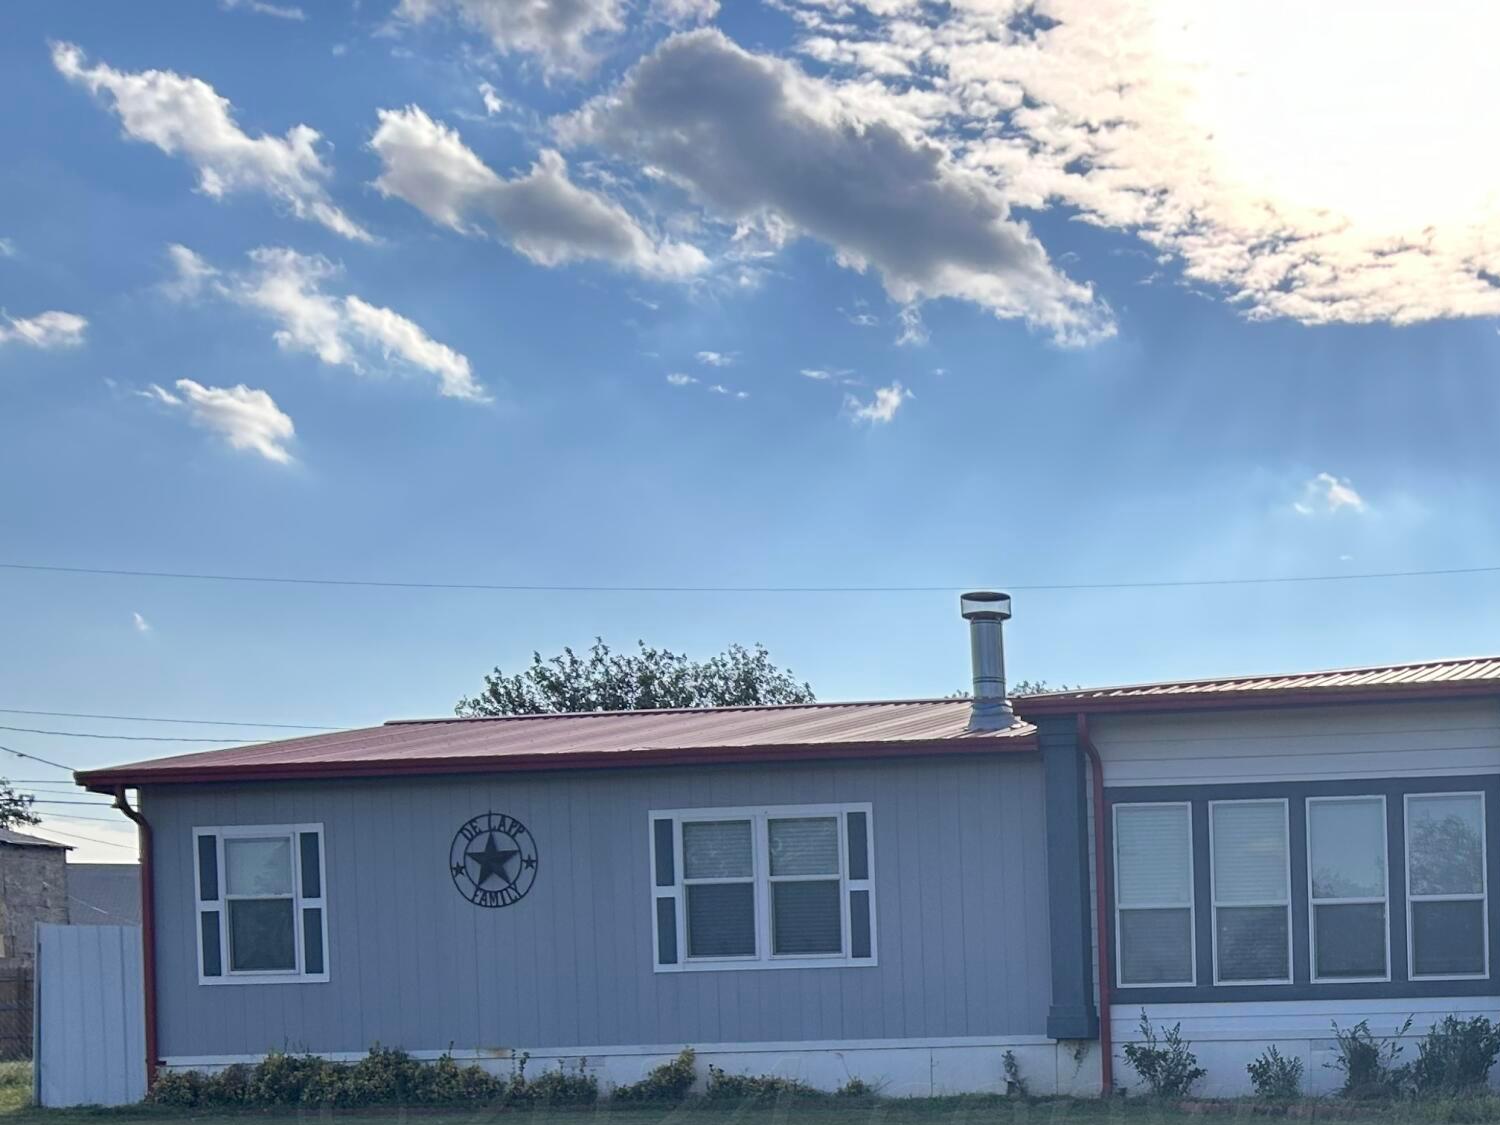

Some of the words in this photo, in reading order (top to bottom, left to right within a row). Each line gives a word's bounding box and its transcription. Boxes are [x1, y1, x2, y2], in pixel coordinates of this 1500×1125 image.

[458, 818, 482, 842] DE
[488, 811, 526, 839] LAPP
[471, 880, 523, 907] FAMILY
